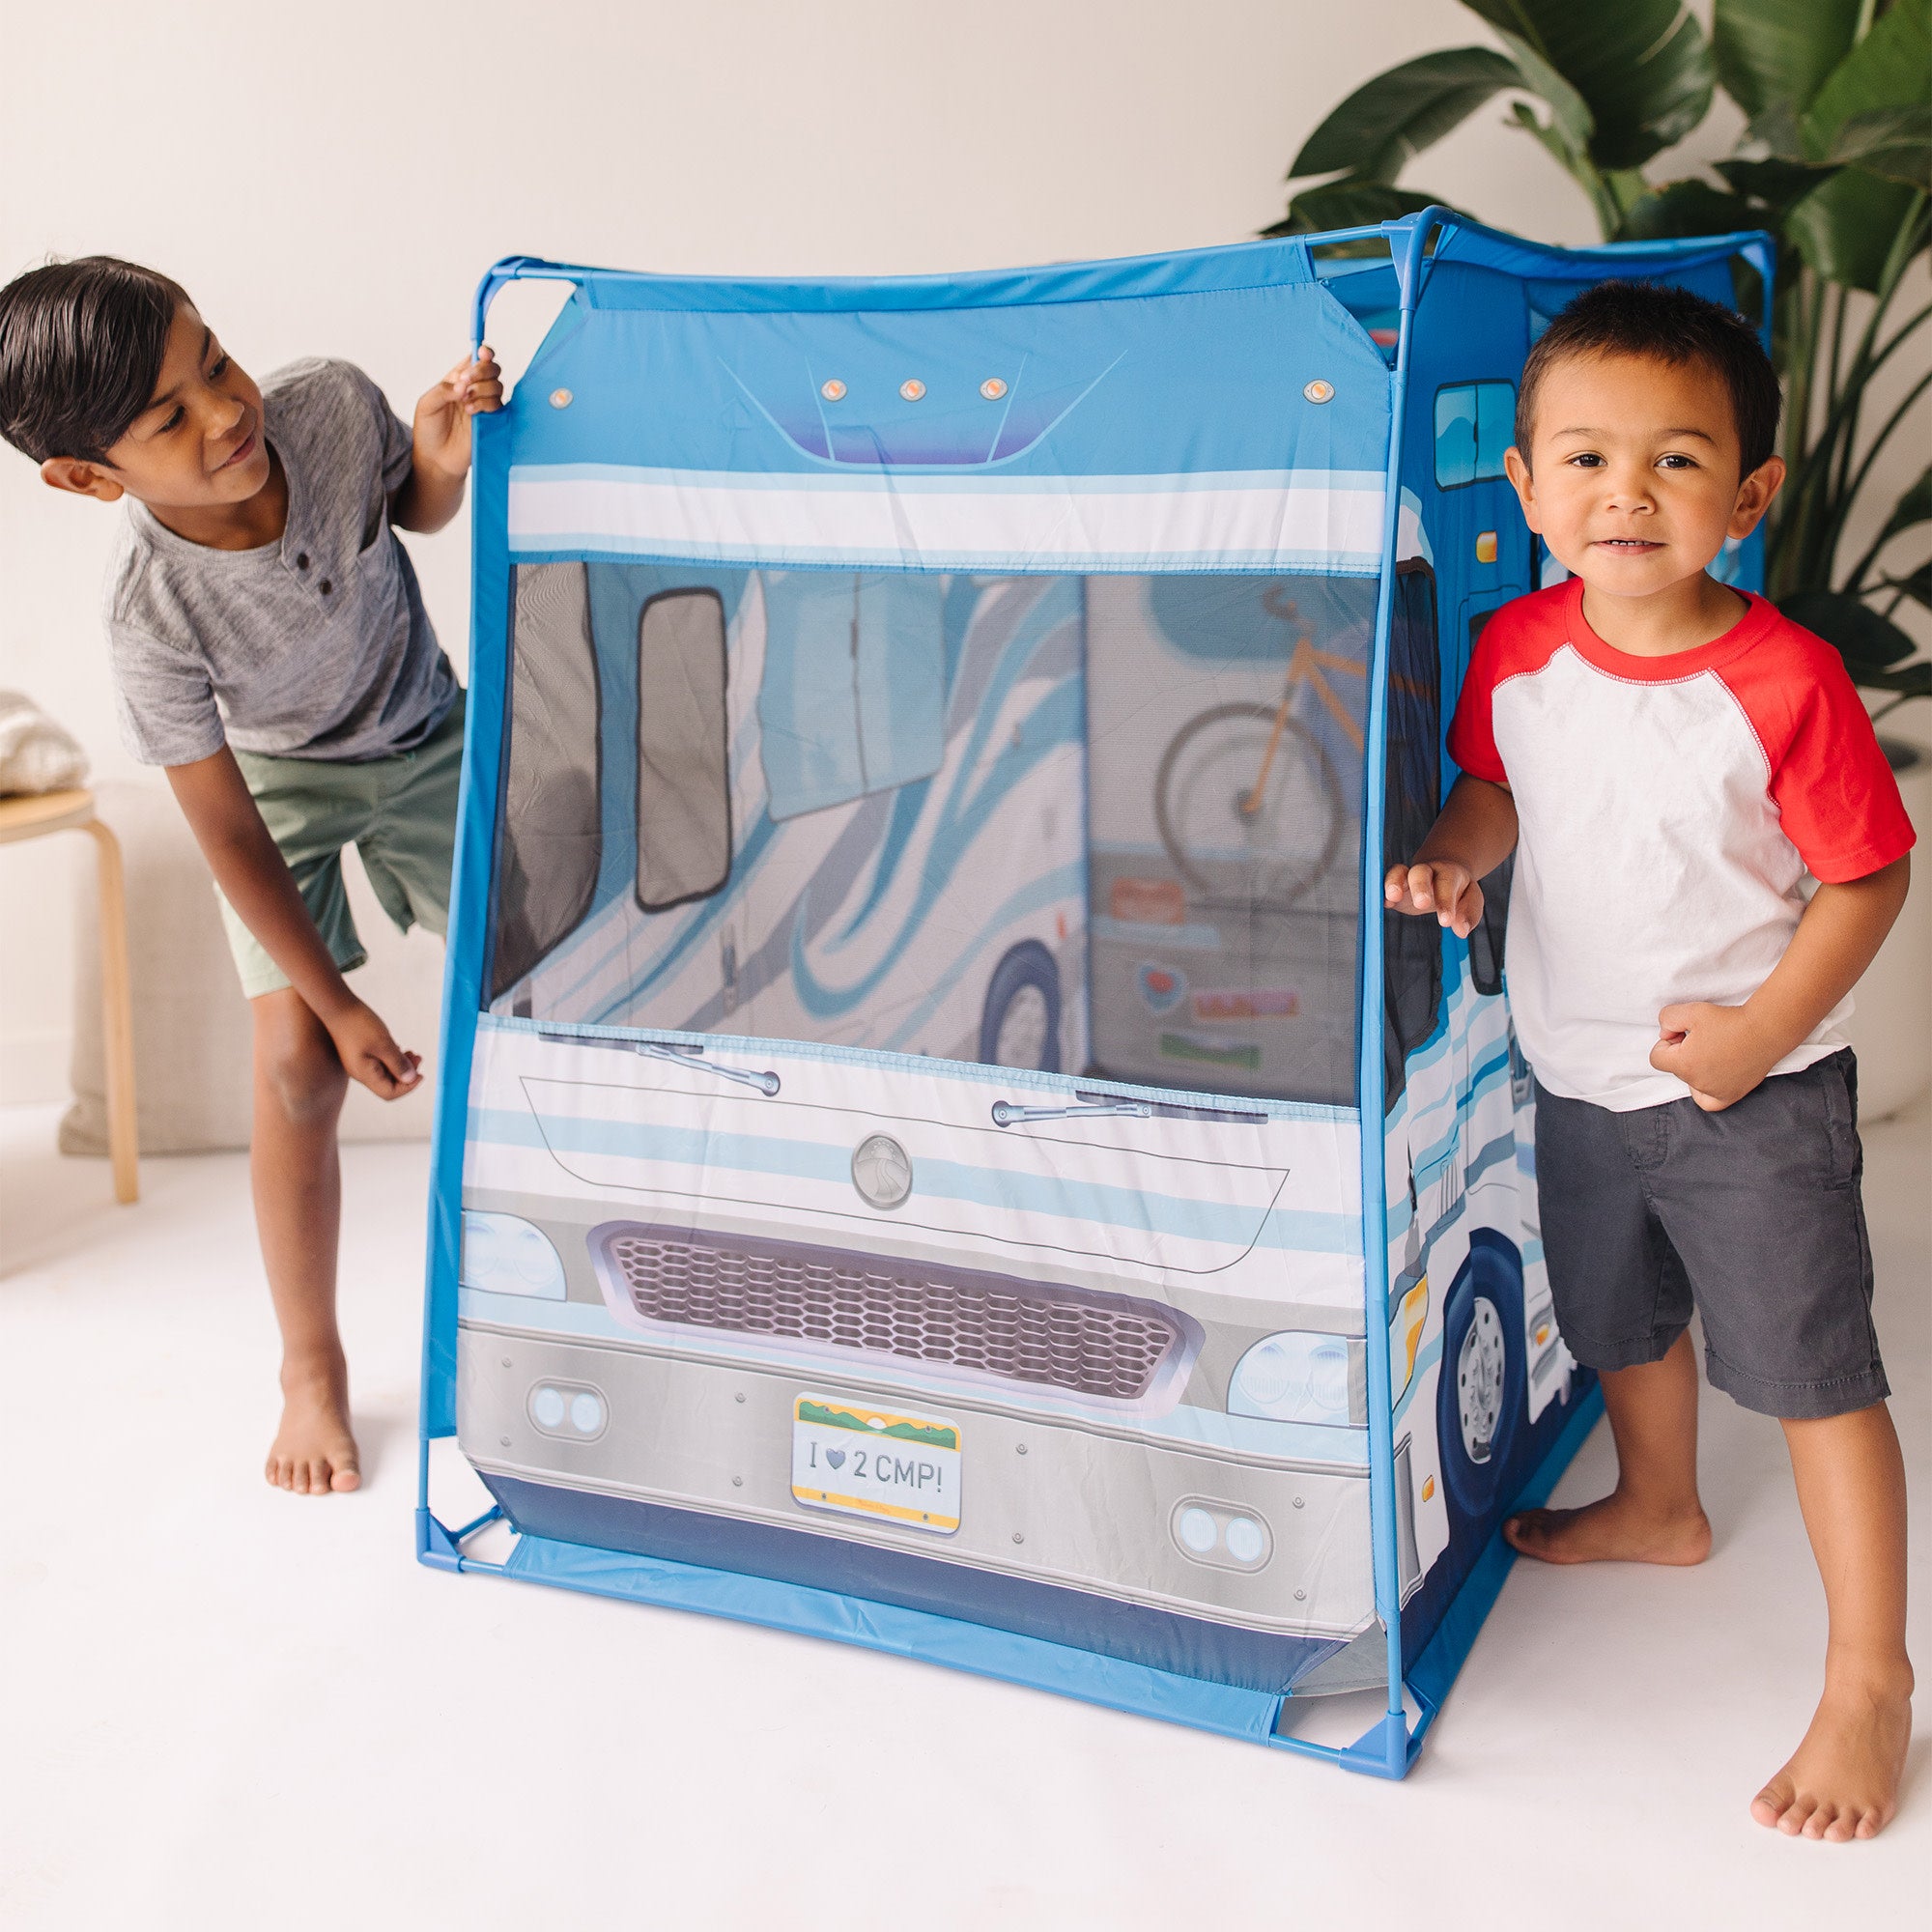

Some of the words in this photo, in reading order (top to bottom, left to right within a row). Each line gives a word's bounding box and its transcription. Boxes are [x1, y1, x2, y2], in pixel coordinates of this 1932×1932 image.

[810, 1441, 817, 1468] I
[854, 1450, 867, 1478] 2
[875, 1454, 942, 1493] CMP!
